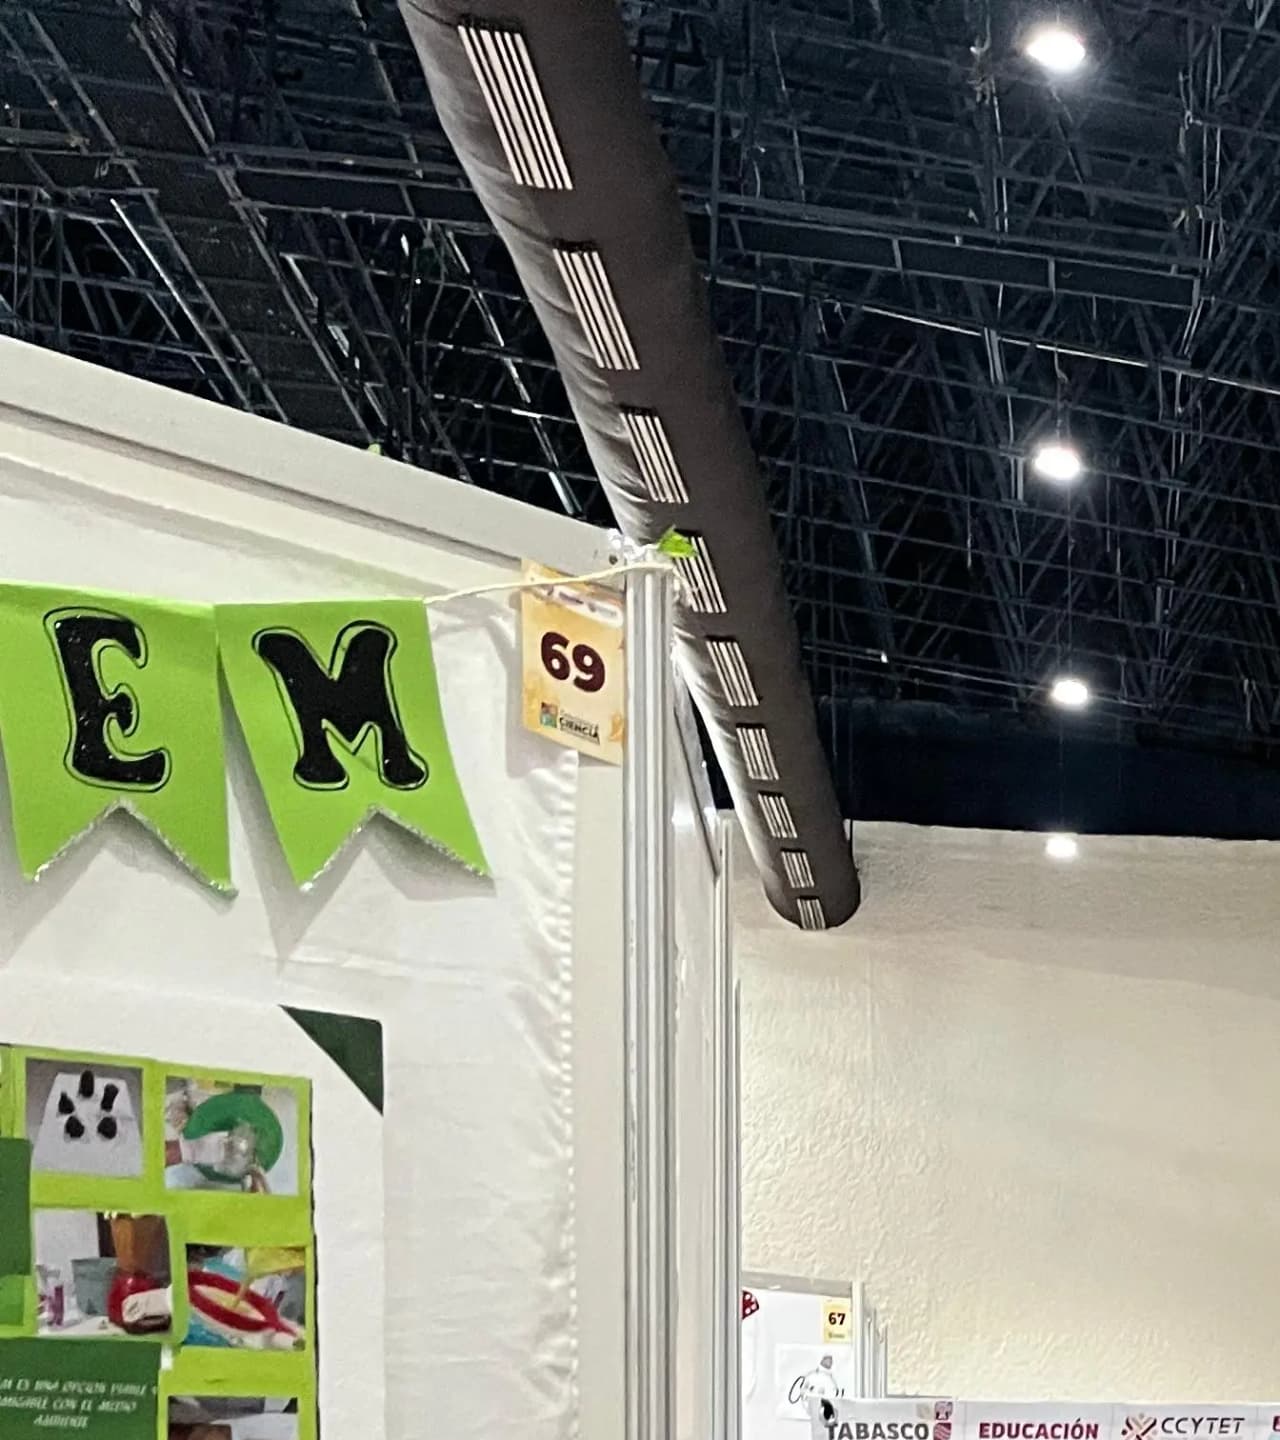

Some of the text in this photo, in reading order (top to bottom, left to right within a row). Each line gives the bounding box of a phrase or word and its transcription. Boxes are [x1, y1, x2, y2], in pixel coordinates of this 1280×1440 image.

[541, 631, 605, 693] 69
[828, 1312, 846, 1325] 67
[826, 1418, 1099, 1440] TABASCO EDUCACIÓN
[1161, 1416, 1245, 1435] CCYTET
